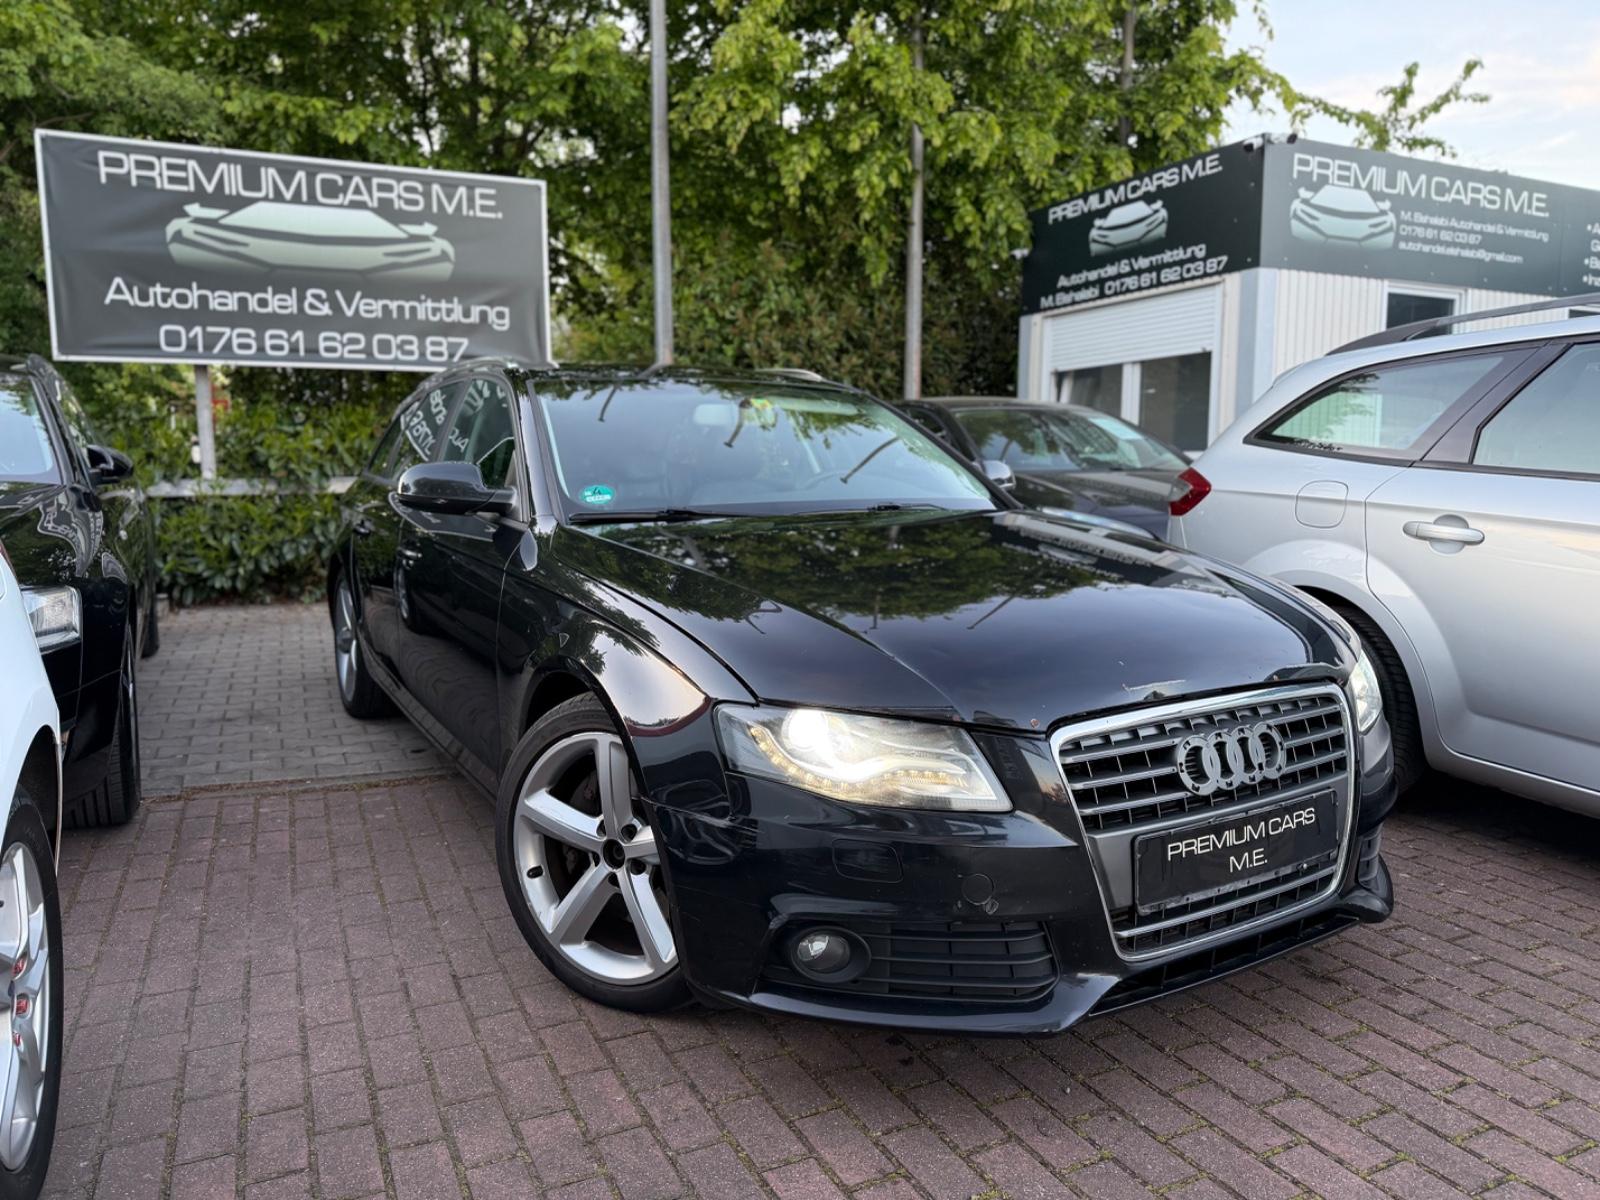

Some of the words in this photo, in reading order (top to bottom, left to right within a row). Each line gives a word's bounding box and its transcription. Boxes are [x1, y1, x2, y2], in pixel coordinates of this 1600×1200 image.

[98, 150, 307, 202] PREMIUM
[315, 172, 424, 213] CARS
[432, 182, 503, 219] M.E.
[1048, 187, 1125, 225] PREMIUM
[1126, 168, 1179, 199] CARS
[1181, 154, 1223, 183] M.E.
[1293, 153, 1427, 199] PREMIUM
[1430, 176, 1500, 210] CARS
[1504, 188, 1550, 218] M.E.
[1399, 224, 1425, 238] 0176
[1426, 228, 1438, 240] 61
[1439, 230, 1453, 242] 62
[1454, 232, 1468, 244] 03
[1450, 217, 1496, 233] Autohandel
[1504, 225, 1549, 243] Vermittlung
[1057, 262, 1118, 288] Autohandel
[1119, 259, 1131, 273] &
[1131, 244, 1206, 271] Vermittlung
[1104, 277, 1139, 295] 0176
[1140, 273, 1157, 288] 61
[1160, 267, 1181, 283] 62
[1182, 261, 1204, 278] 03
[1206, 255, 1228, 273] 87
[104, 276, 298, 315] Autohandel
[303, 289, 332, 317] &
[336, 290, 509, 330] Vermittlung
[159, 324, 256, 355] 0176
[263, 327, 305, 356] 61
[318, 331, 366, 360] 62
[371, 333, 419, 361] 03
[425, 335, 470, 363] 87
[1167, 821, 1266, 861] PREMIUM
[1268, 807, 1316, 836] CARS
[1229, 848, 1268, 873] M.E.
